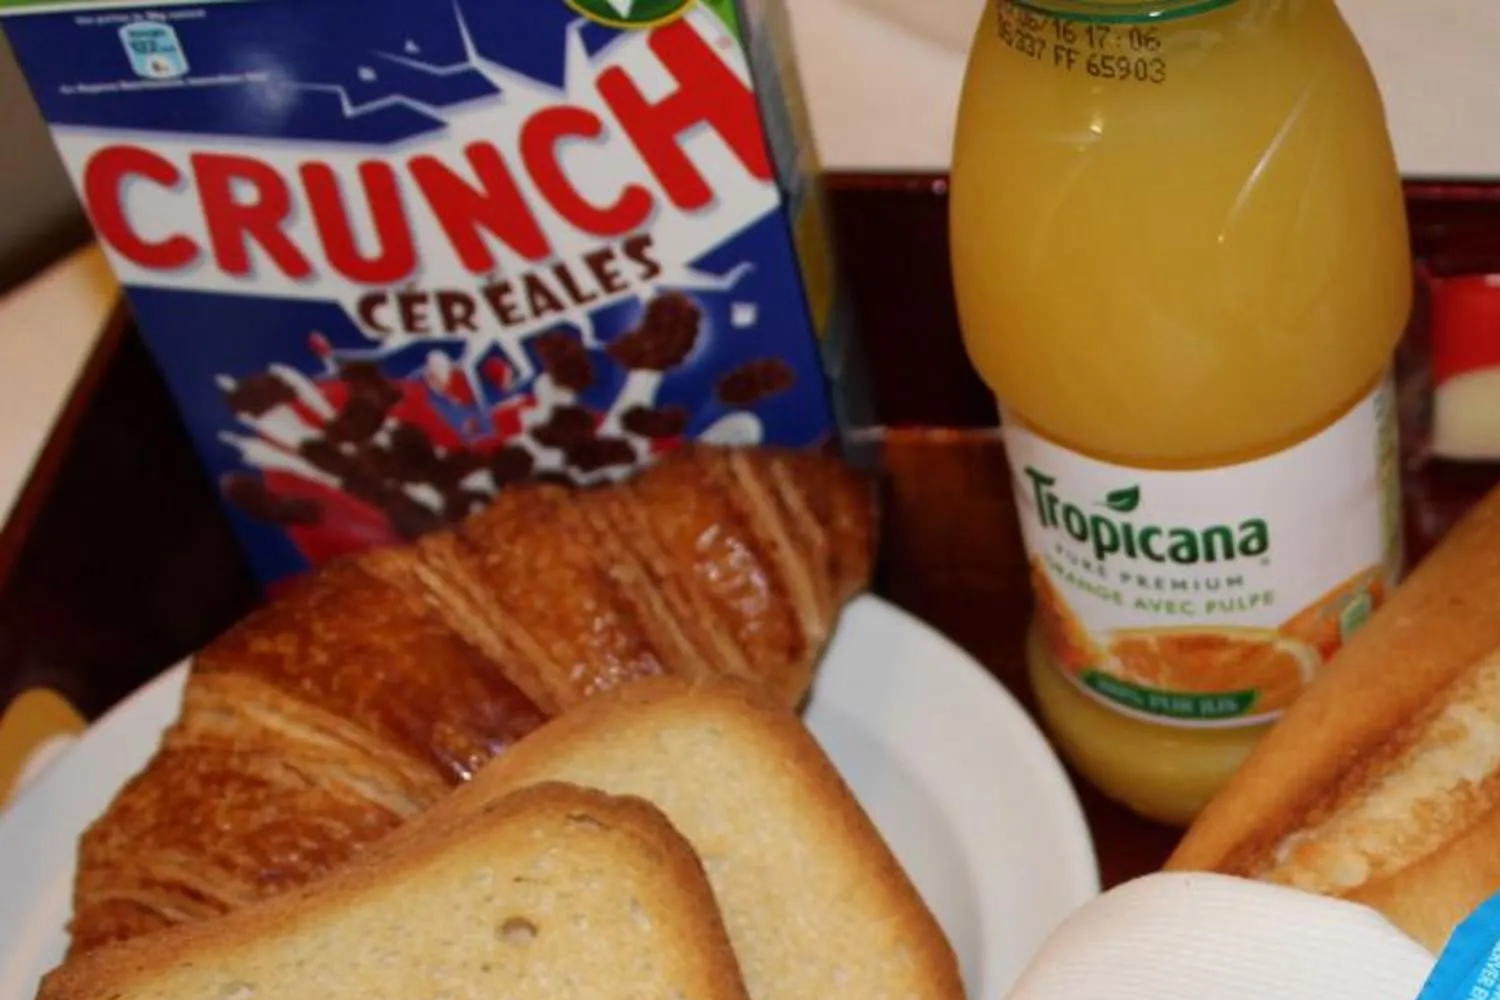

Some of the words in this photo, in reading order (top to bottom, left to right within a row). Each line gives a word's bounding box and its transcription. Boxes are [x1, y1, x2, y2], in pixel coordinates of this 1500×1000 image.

[1054, 44, 1079, 70] FF
[1087, 53, 1166, 83] 65903
[84, 19, 776, 284] CRUNCH
[1025, 466, 1269, 564] Tropicana
[1121, 572, 1244, 591] PREMIUM
[1134, 597, 1195, 615] AVEC
[1205, 591, 1275, 615] PULPE
